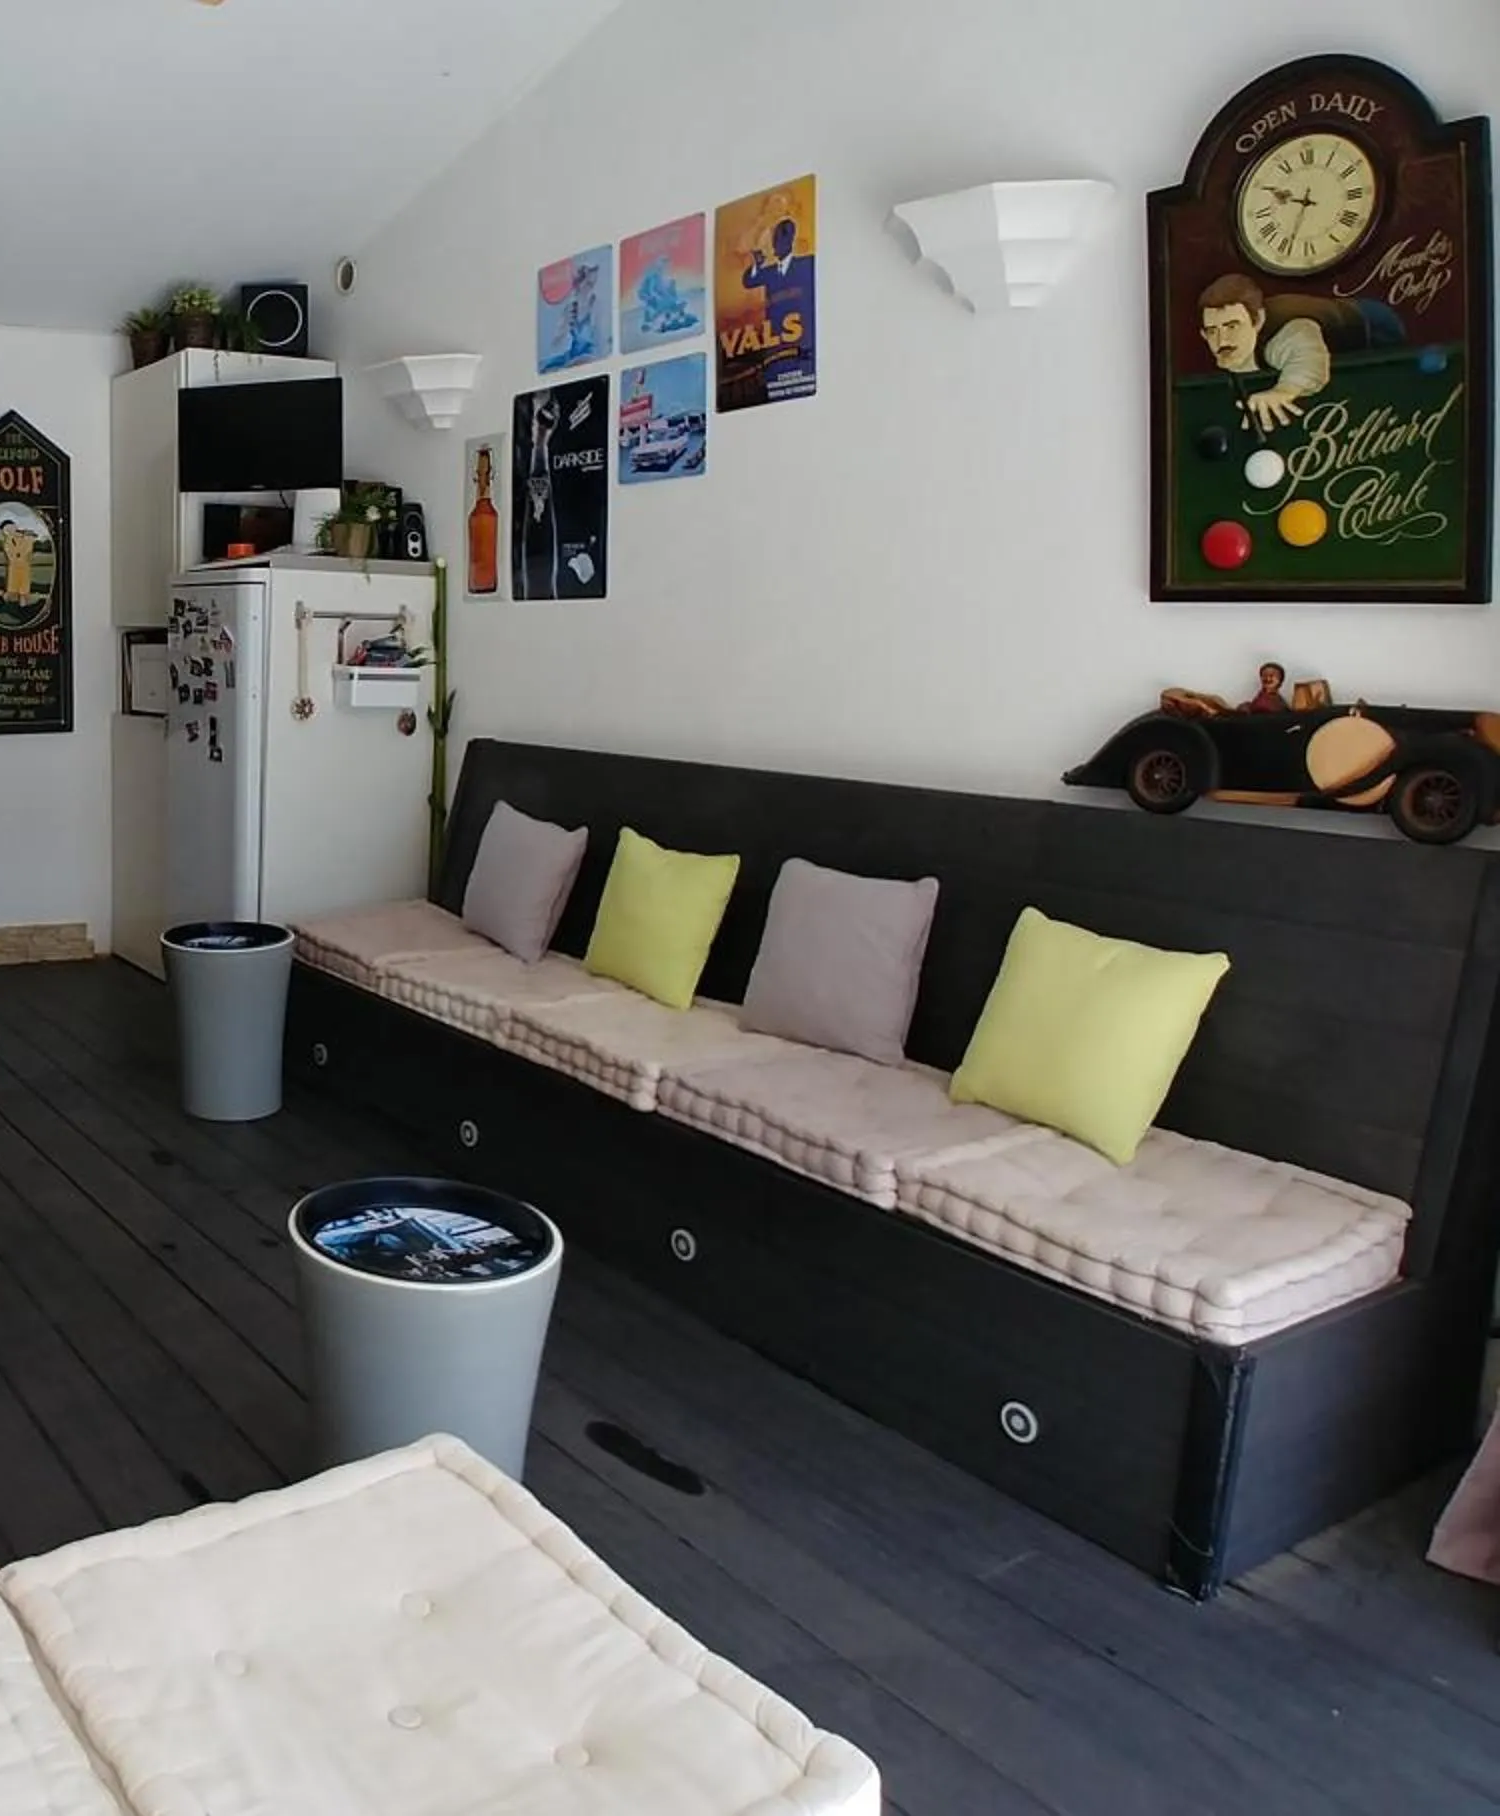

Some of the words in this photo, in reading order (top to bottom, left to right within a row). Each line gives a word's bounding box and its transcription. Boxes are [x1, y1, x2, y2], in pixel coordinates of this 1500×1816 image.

[1235, 101, 1297, 153] OPEN
[1310, 92, 1385, 123] DAILY
[1388, 262, 1452, 315] Only
[720, 312, 803, 358] VALS
[1242, 382, 1464, 515] Billiard
[1323, 461, 1448, 546] Club
[13, 623, 60, 654] HOUSE
